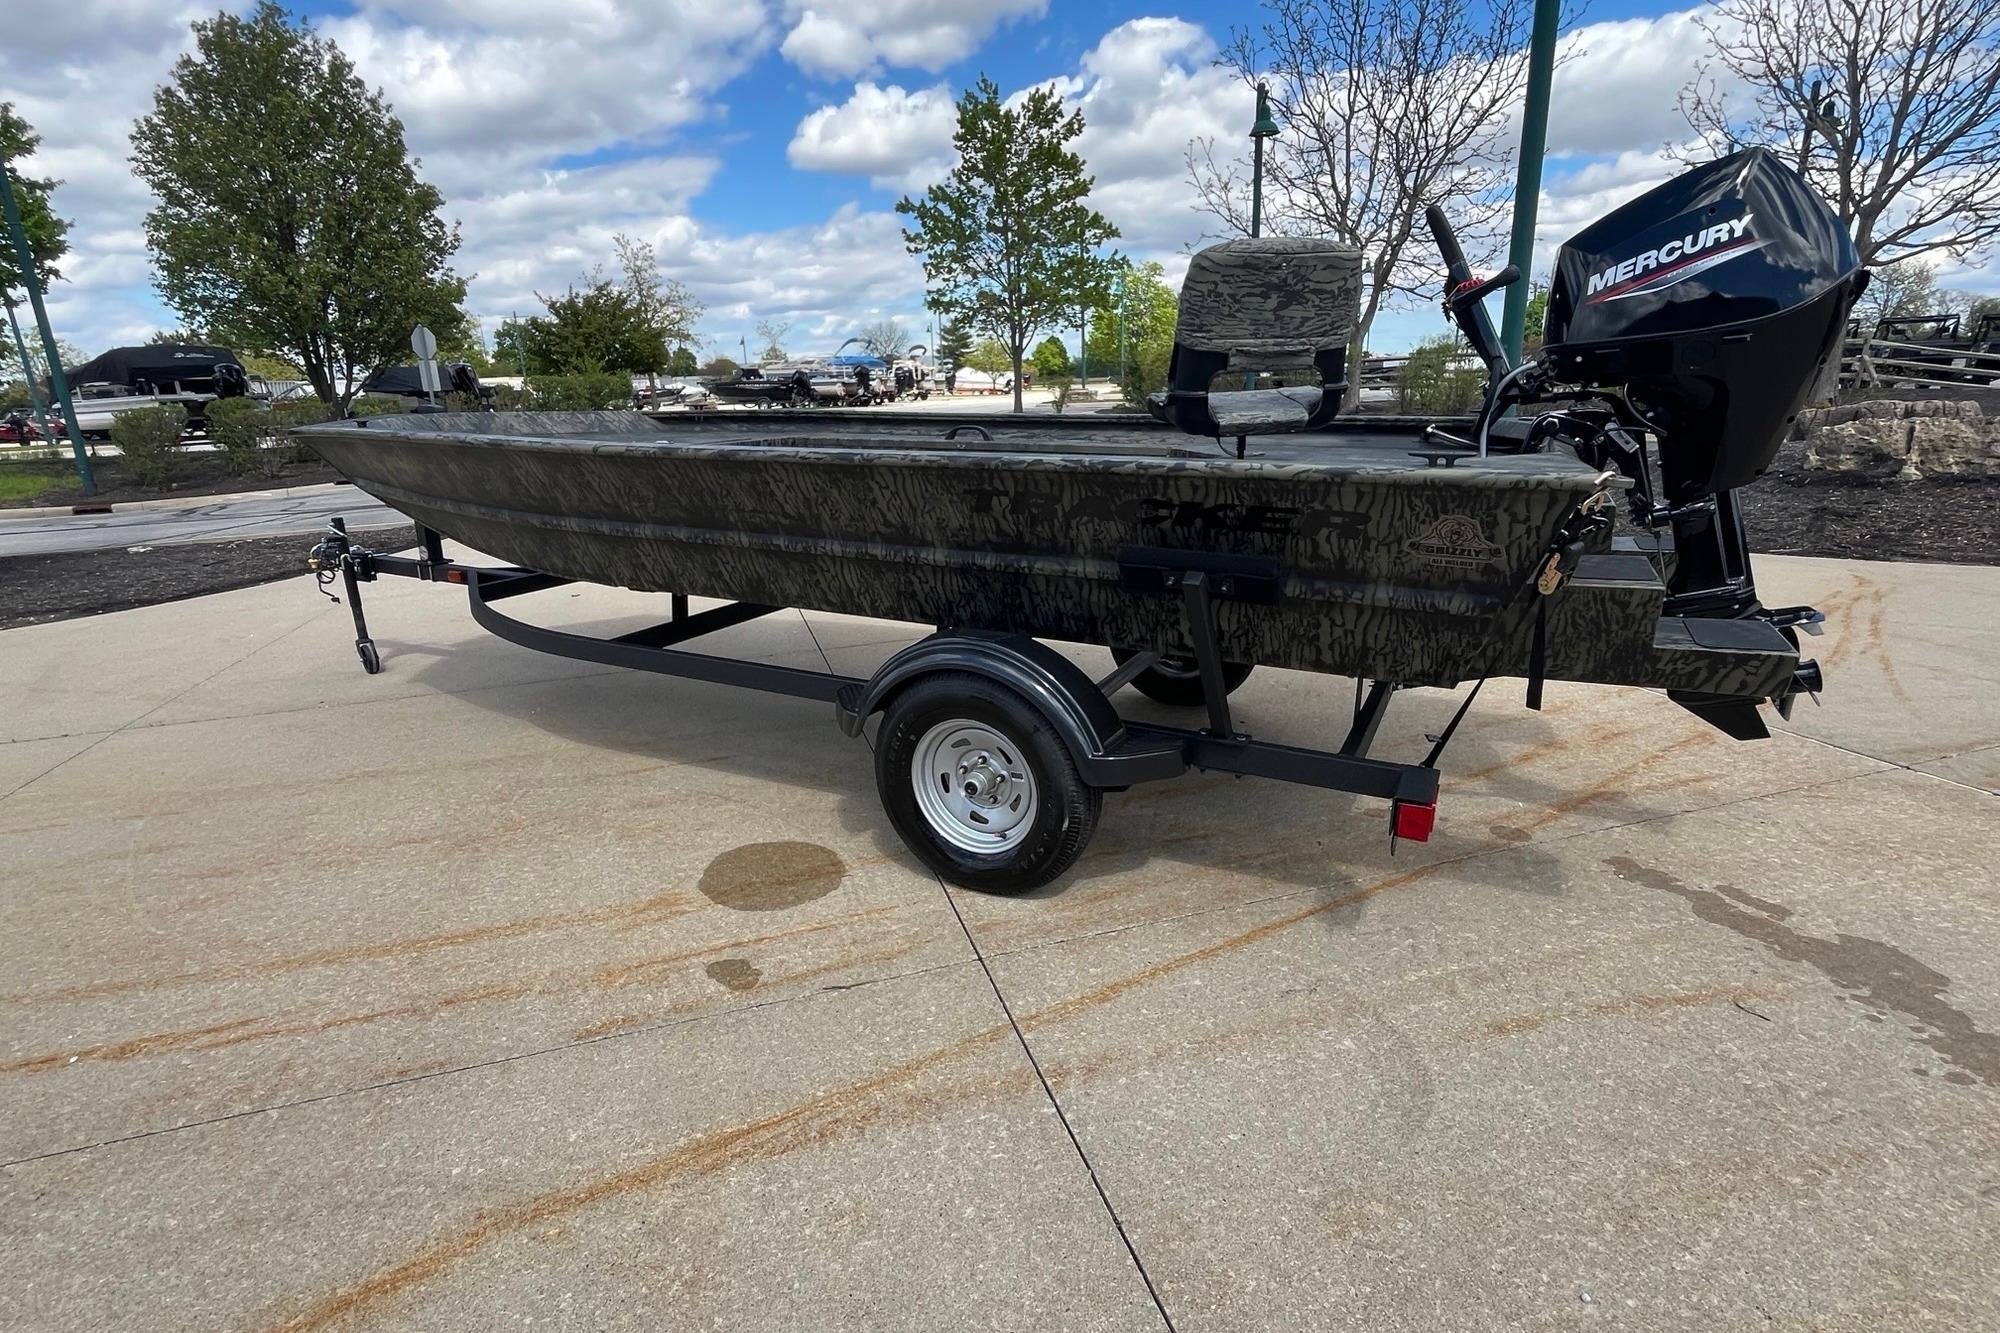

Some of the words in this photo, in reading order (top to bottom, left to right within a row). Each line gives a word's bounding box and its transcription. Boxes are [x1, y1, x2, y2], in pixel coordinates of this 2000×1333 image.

[1587, 214, 1754, 296] MERCURY
[962, 487, 1371, 537] TRACKER
[1424, 546, 1482, 557] GRIZZLY
